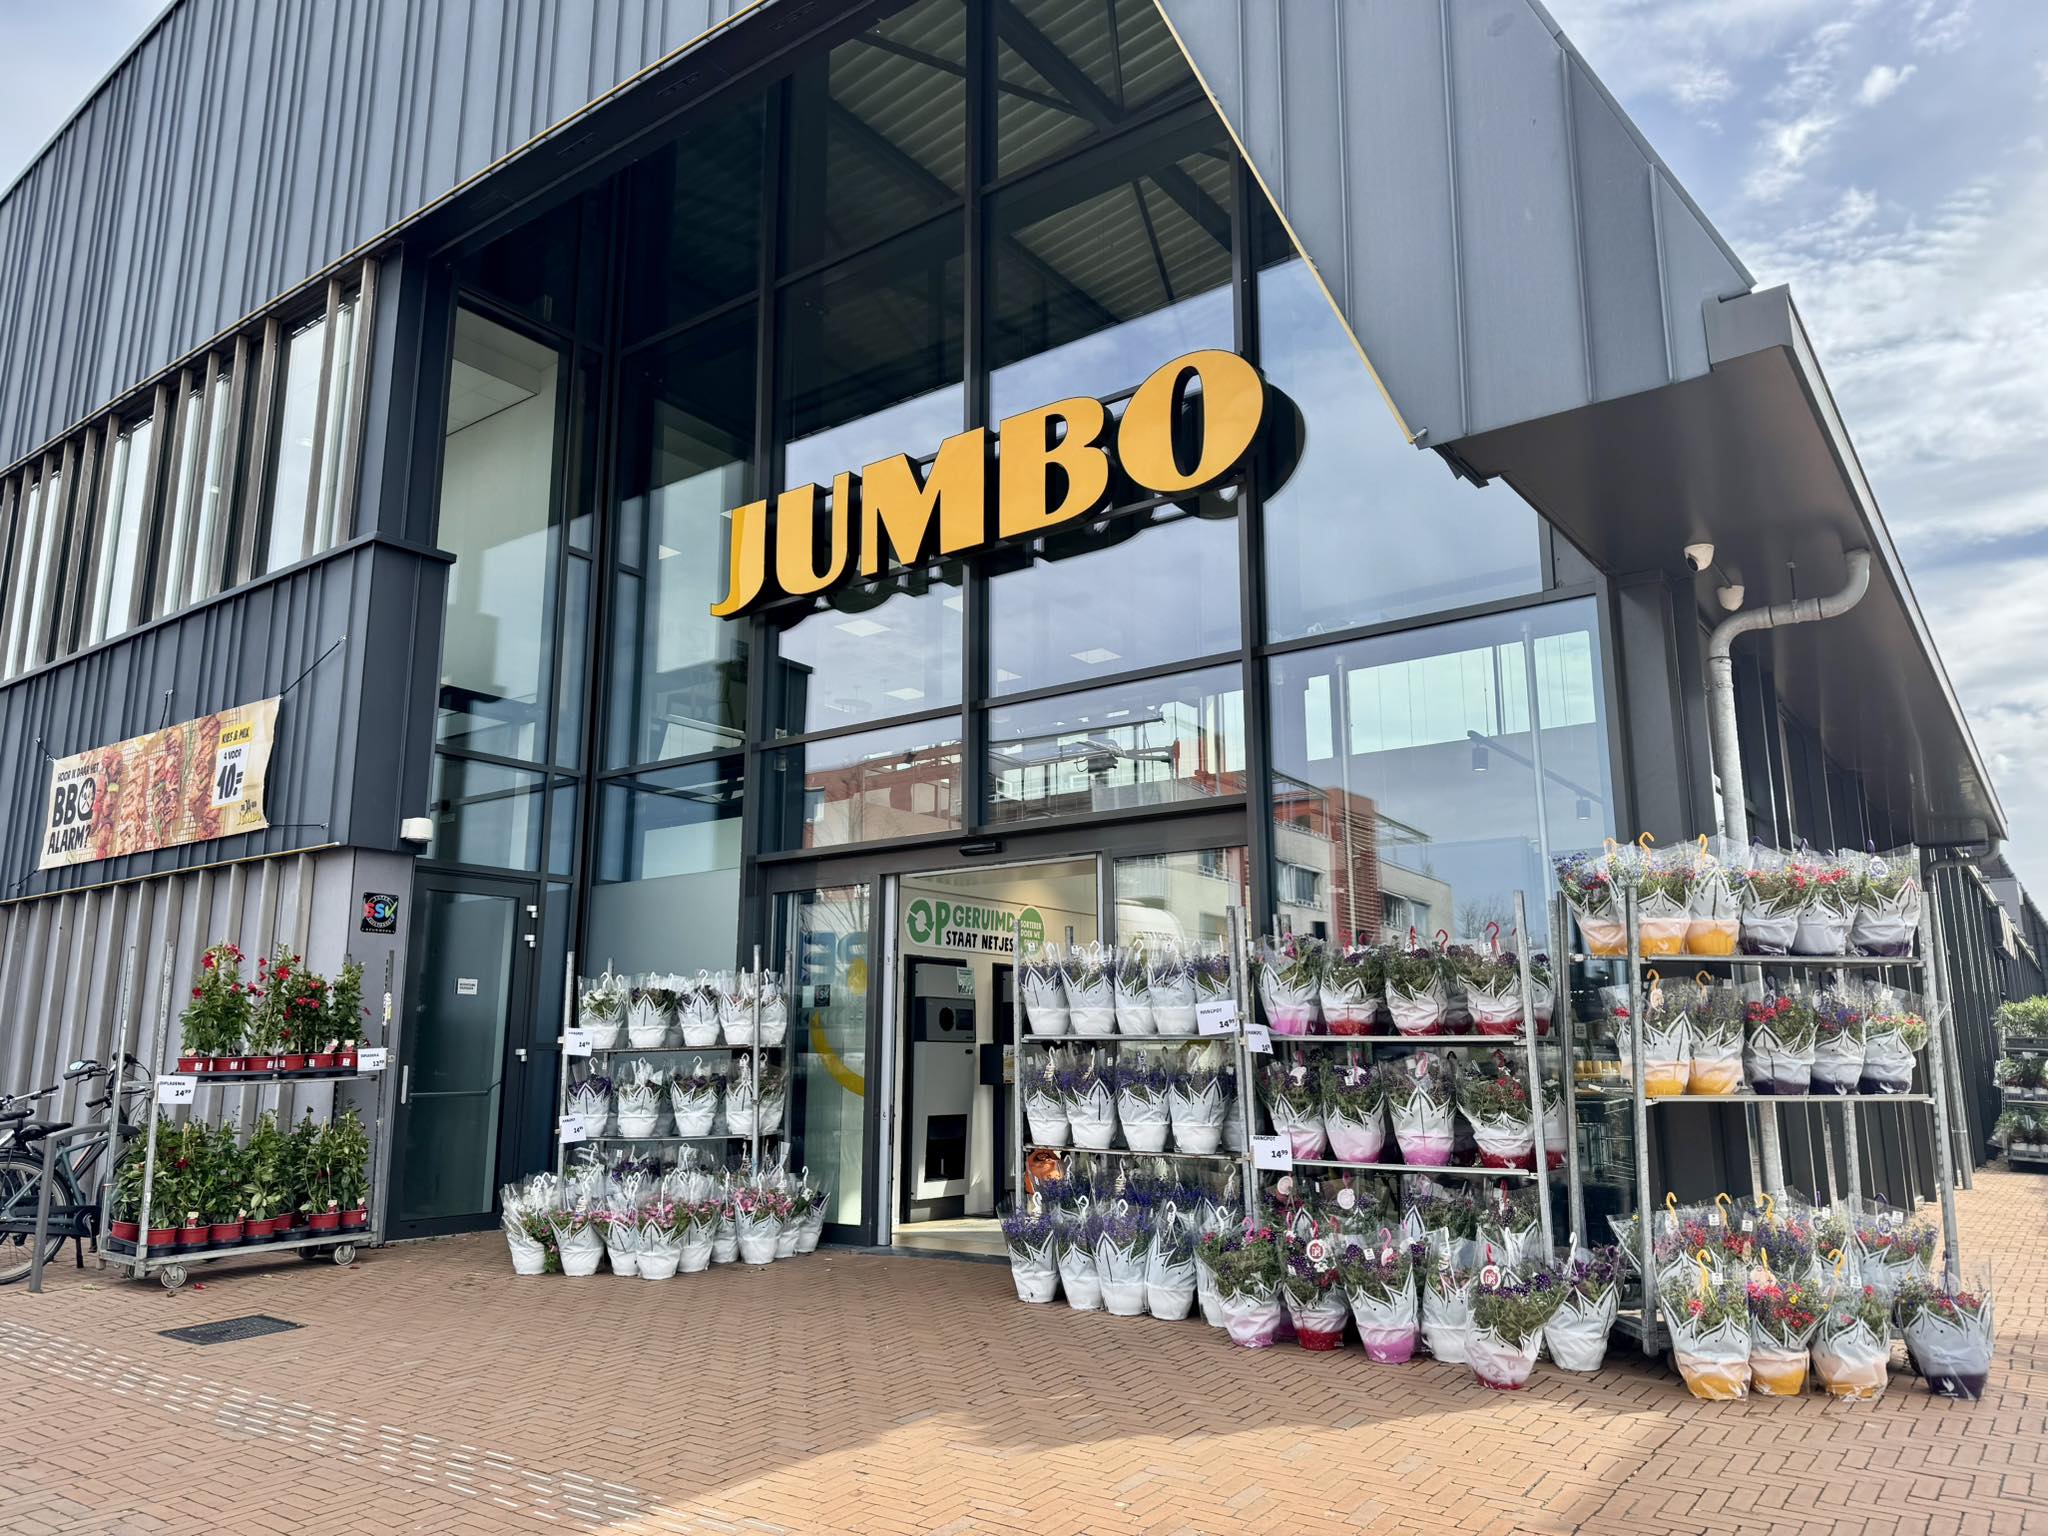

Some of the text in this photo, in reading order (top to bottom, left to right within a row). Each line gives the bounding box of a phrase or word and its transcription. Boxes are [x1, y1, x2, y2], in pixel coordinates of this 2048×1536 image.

[710, 348, 1266, 618] JUMBO
[57, 770, 71, 783] HOOR
[76, 765, 90, 778] DAAR
[90, 762, 100, 773] HET
[51, 777, 96, 828] BBQ
[47, 824, 92, 855] ALARM?
[945, 930, 978, 948] STAAT
[981, 935, 1014, 952] NETJES
